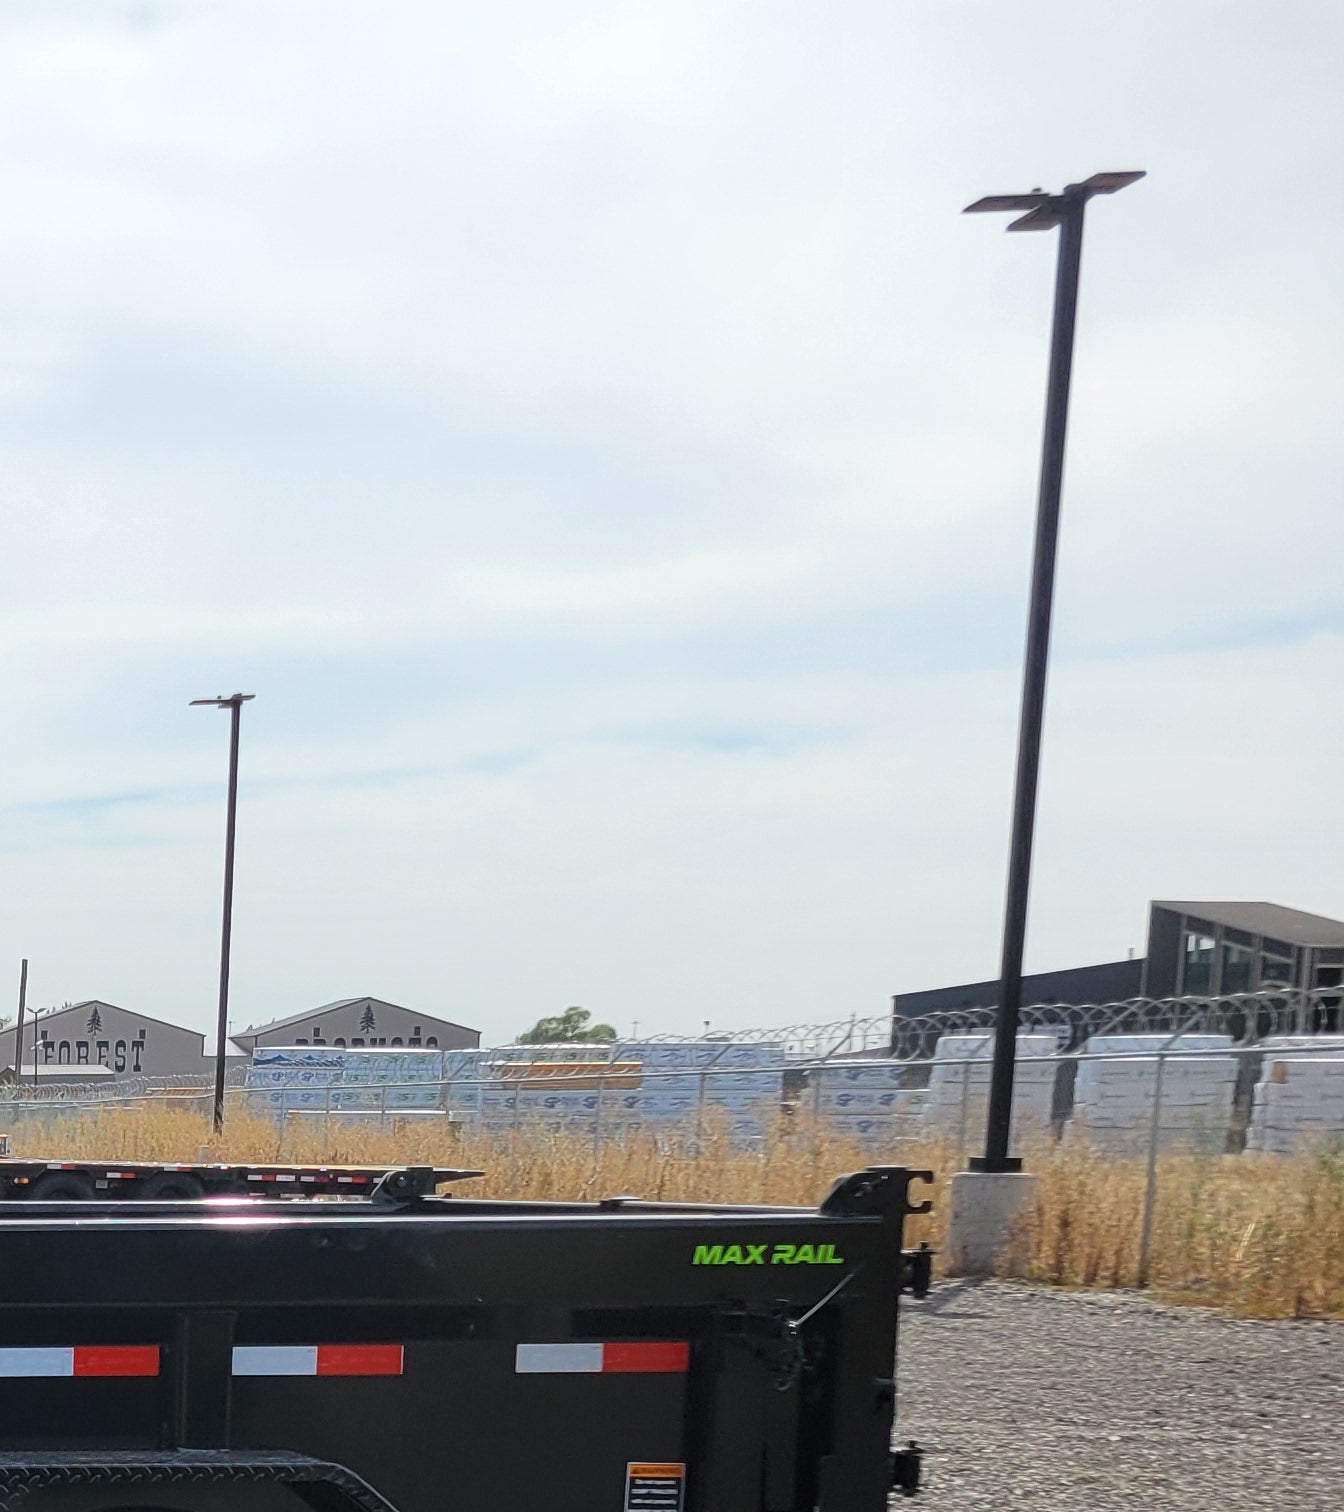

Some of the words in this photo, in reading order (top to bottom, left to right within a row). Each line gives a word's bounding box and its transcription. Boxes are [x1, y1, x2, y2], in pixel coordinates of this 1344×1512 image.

[42, 1039, 145, 1073] FOREST
[692, 1244, 769, 1266] MAX
[771, 1244, 845, 1265] RAIL
